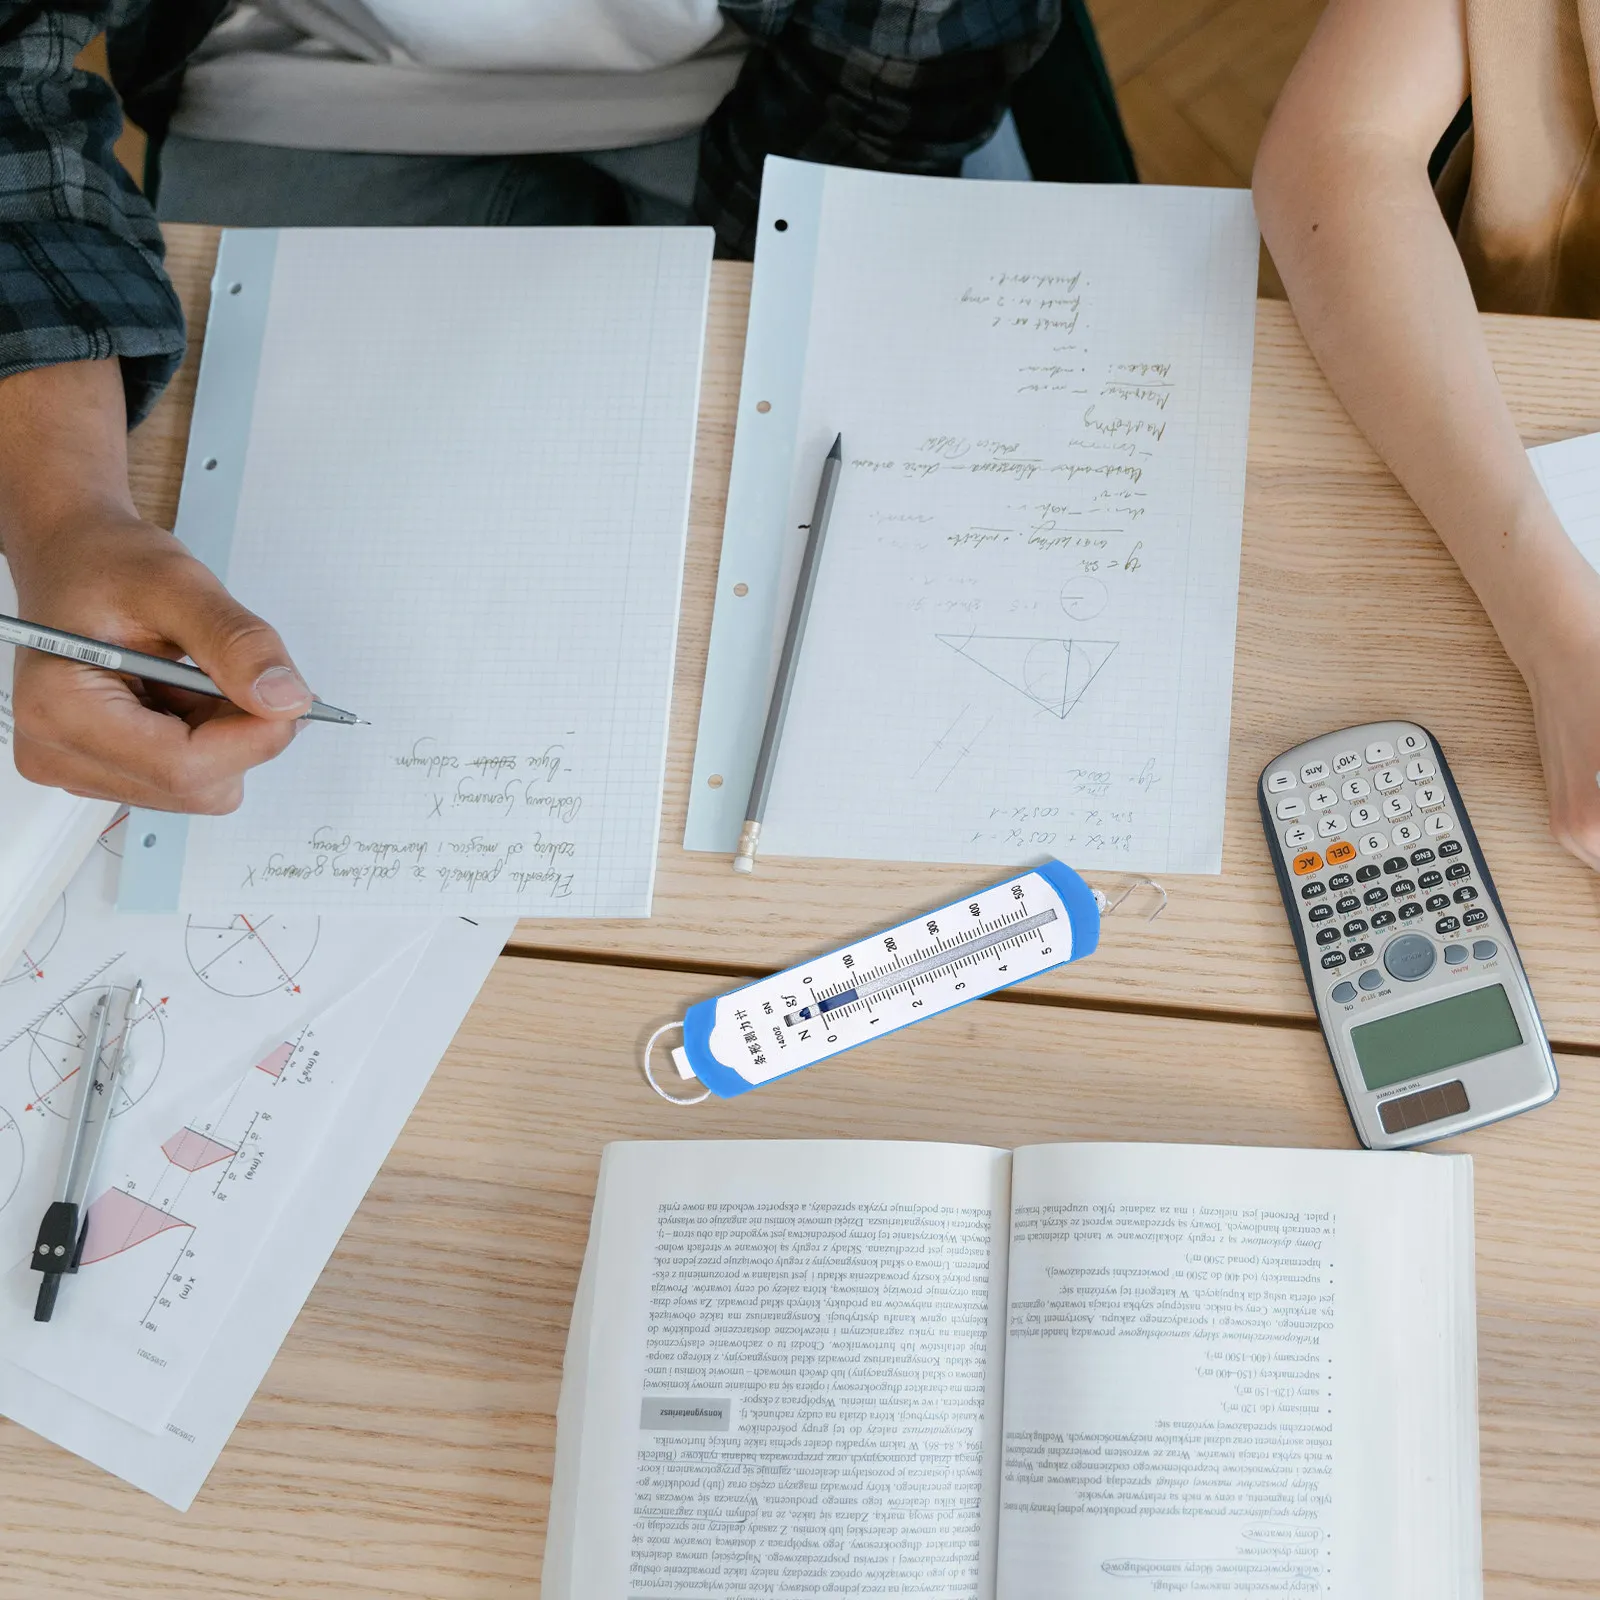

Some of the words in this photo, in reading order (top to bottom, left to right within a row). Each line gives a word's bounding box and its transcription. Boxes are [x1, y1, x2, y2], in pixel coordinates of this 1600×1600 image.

[1404, 735, 1416, 748] 0
[1305, 765, 1322, 776] Ans
[1391, 799, 1401, 811] 5
[1358, 809, 1369, 820] 6
[1399, 825, 1411, 839] 8
[1367, 836, 1378, 850] 9
[1441, 841, 1458, 853] RCL
[506, 842, 523, 867] od
[1329, 845, 1351, 860] DEL
[1413, 849, 1432, 863] ENG
[1299, 856, 1314, 869] AC
[241, 867, 256, 888] X
[1010, 884, 1025, 902] 500
[1306, 883, 1322, 896] M+
[1368, 891, 1381, 901] sin
[1340, 898, 1356, 910] cos
[968, 902, 983, 919] 400
[1313, 906, 1329, 918] tan
[1466, 911, 1484, 922] CALC
[926, 919, 940, 937] 300
[1348, 920, 1362, 934] log
[884, 935, 898, 953] 200
[842, 953, 856, 970] 100
[998, 964, 1009, 974] 4
[802, 975, 814, 985] 0
[1377, 988, 1392, 998] MODE
[762, 1001, 774, 1017] 5N
[911, 998, 923, 1009] 2
[735, 1008, 766, 1066] 条形测力计
[798, 1030, 811, 1041] N
[659, 1202, 681, 1212] rynki
[720, 1204, 754, 1213] wchodzi
[757, 1202, 799, 1212] eksporter
[859, 1202, 888, 1212] ryzyka
[890, 1203, 938, 1215] podejmuje
[941, 1206, 954, 1215] nie
[710, 1215, 747, 1225] angażuje
[750, 1217, 762, 1225] nie
[764, 1217, 796, 1225] komisu
[797, 1217, 832, 1226] umowie
[835, 1216, 863, 1227] Dzięki
[1077, 1284, 1117, 1295] wyróżnia
[1119, 1286, 1132, 1296] tej
[1135, 1287, 1175, 1297] kategorii
[1264, 1291, 1286, 1301] usług
[1290, 1293, 1316, 1302] oferta
[1319, 1293, 1334, 1303] jest
[649, 1310, 696, 1321] obowiązek
[700, 1312, 724, 1322] także
[746, 1311, 820, 1322] Konsygnatariusz
[826, 1311, 879, 1324] dystrybucji.
[883, 1314, 915, 1324] kanału
[920, 1314, 947, 1324] ogniw
[951, 1315, 988, 1325] kolejnych
[660, 1408, 723, 1419] konsygnatariusz
